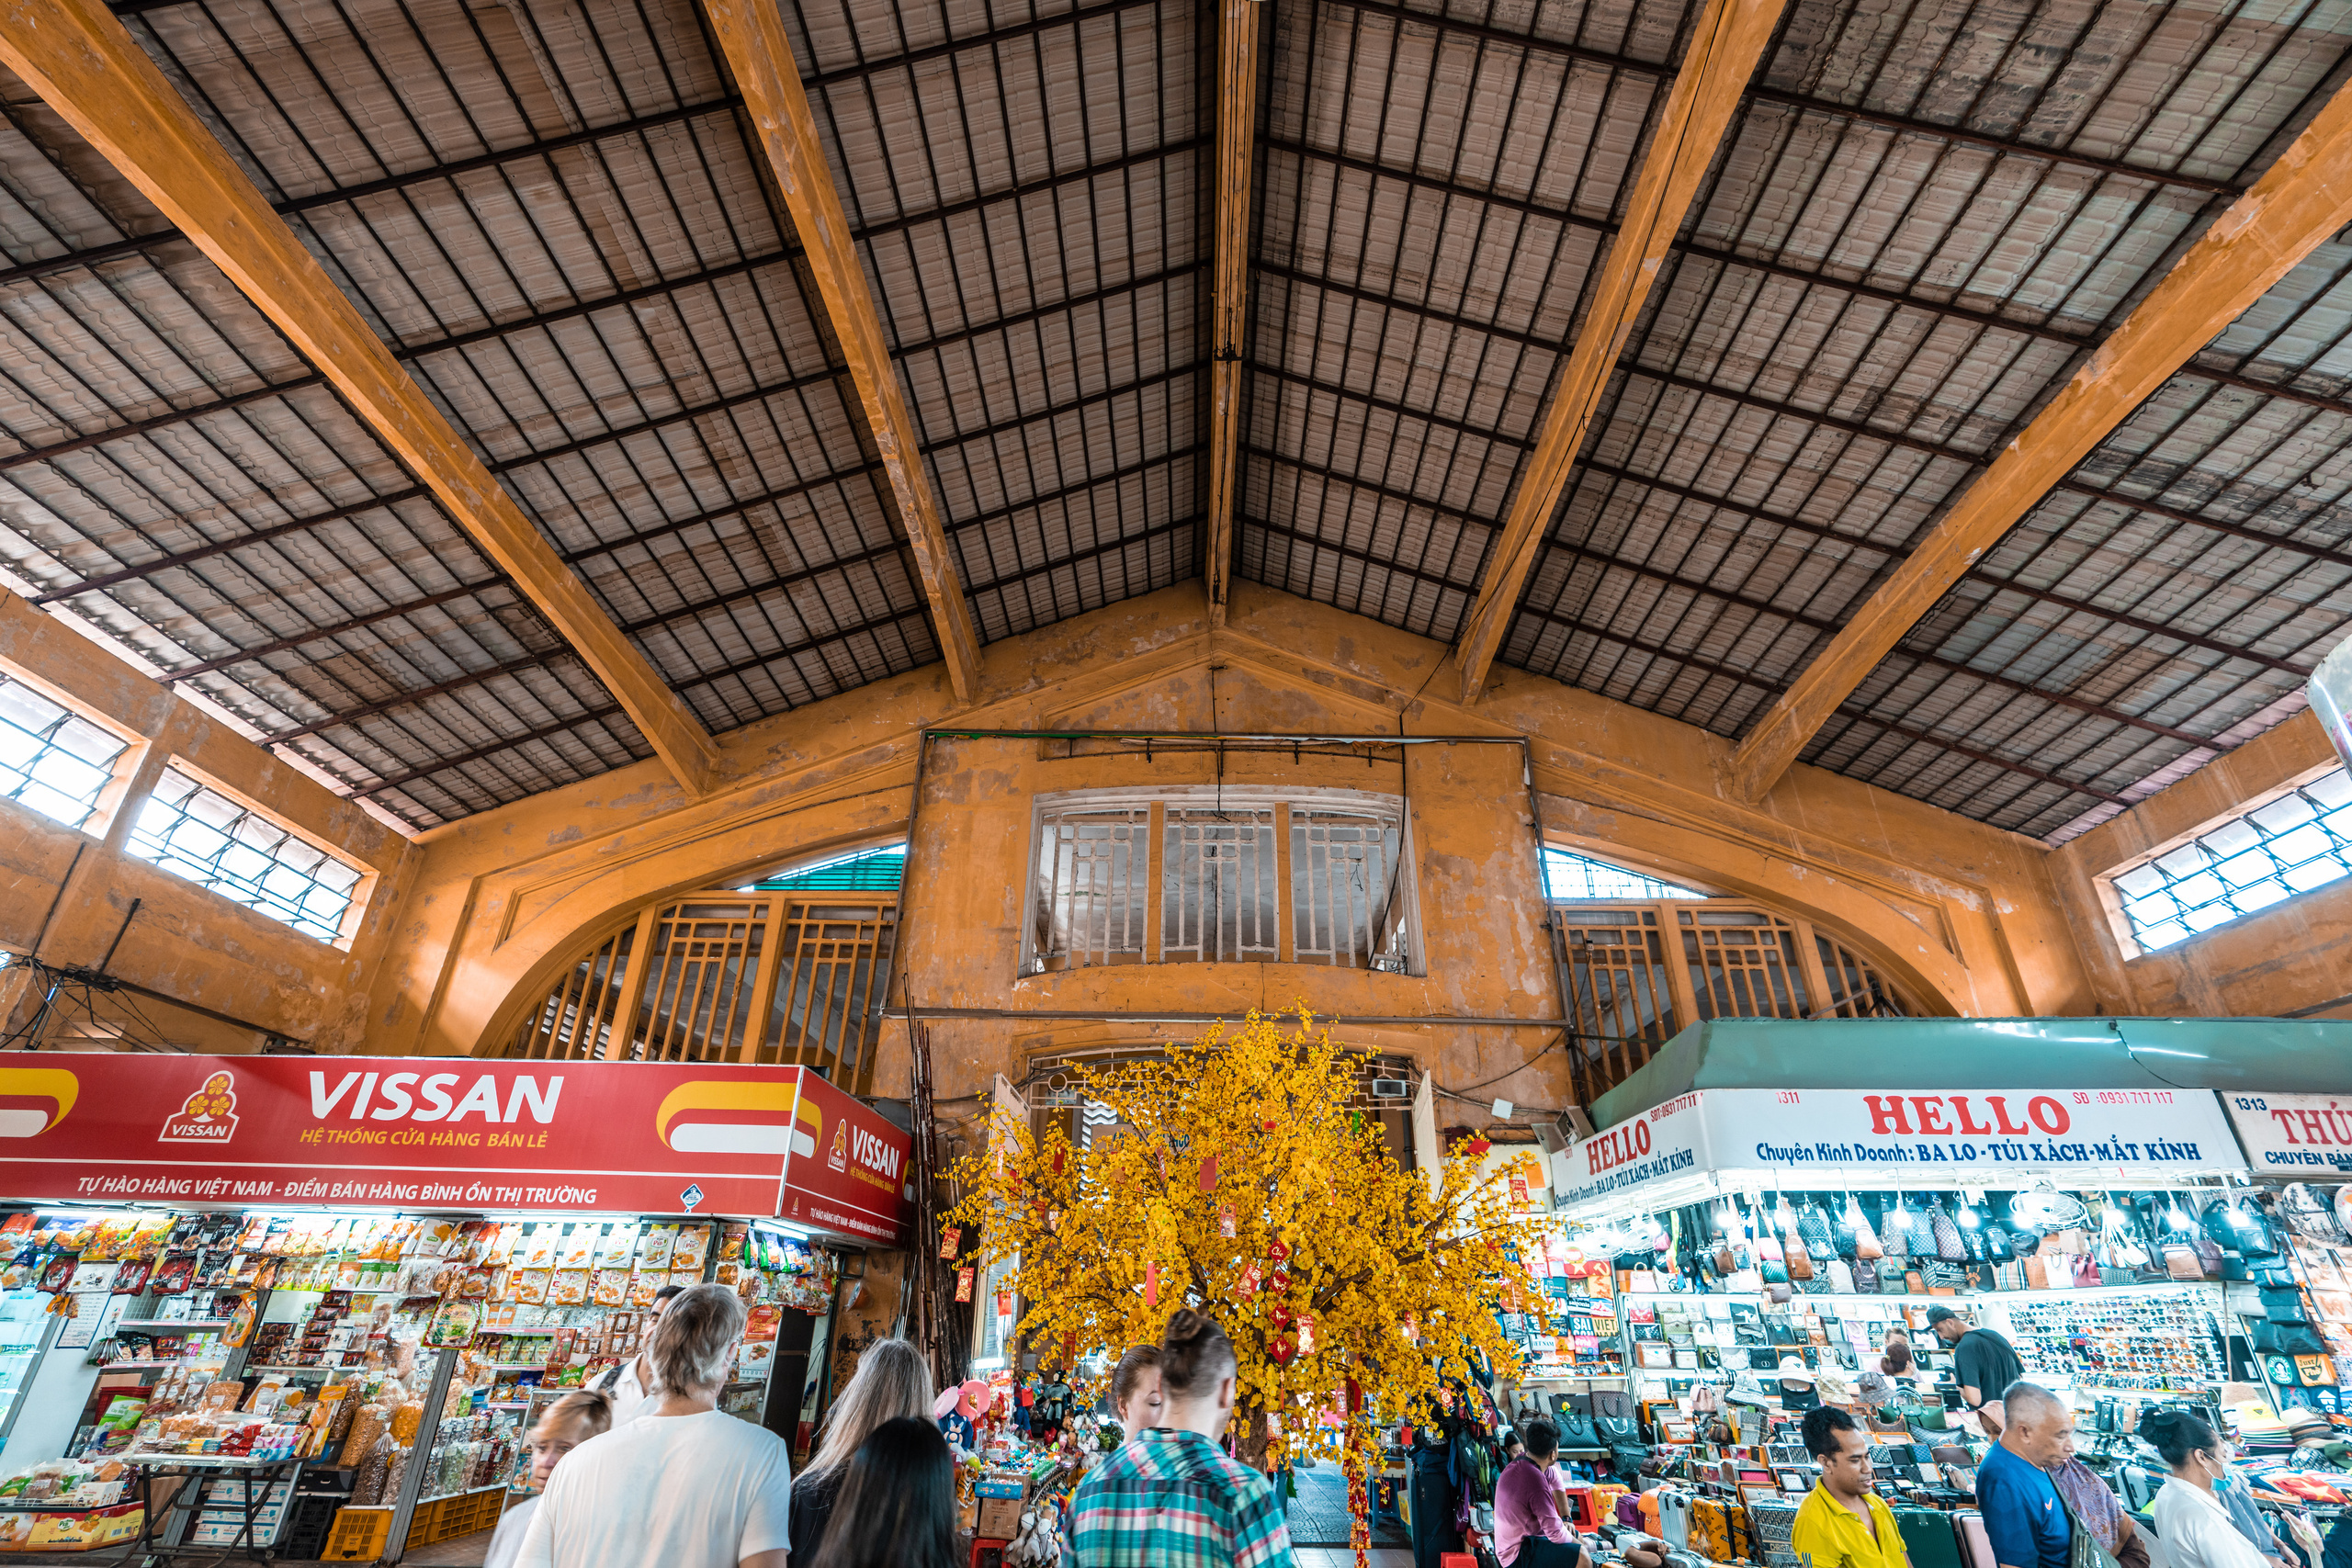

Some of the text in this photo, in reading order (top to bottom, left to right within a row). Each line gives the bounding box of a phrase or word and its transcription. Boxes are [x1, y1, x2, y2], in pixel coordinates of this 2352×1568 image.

[310, 1071, 564, 1123] VISSAN
[1776, 1091, 1800, 1104] 1311
[2235, 1098, 2267, 1111] 1313
[1862, 1095, 2071, 1136] HELLO
[173, 1124, 228, 1137] VISSAN
[300, 1126, 548, 1148] HỆ THỐNG CỬA HÀNG BÁN LẺ
[854, 1124, 899, 1179] VISSAN
[1586, 1119, 1651, 1176] HELLO
[1669, 1146, 1694, 1172] KÍNH
[1756, 1143, 1815, 1167] Chuyên
[1815, 1143, 1853, 1161] Kinh
[1916, 1144, 1949, 1161] BA
[1951, 1144, 1976, 1161] LO
[2143, 1137, 2202, 1161] KÍNH
[2265, 1149, 2324, 1165] CHUYÊN
[831, 1155, 844, 1168] VISSAN
[77, 1175, 105, 1196] TỰ
[101, 1175, 141, 1193] HÀO
[141, 1176, 193, 1194] HÀNG
[194, 1177, 232, 1199] VIỆT
[232, 1180, 274, 1196] NAM
[284, 1177, 327, 1197] ĐIỂM
[329, 1179, 368, 1199] BÁN
[368, 1181, 419, 1200] HÀNG
[420, 1182, 464, 1201] BÌNH
[465, 1180, 492, 1201] ỔN
[494, 1186, 523, 1206] THỊ
[526, 1185, 597, 1204] TRƯỜNG
[1573, 1317, 1591, 1331] SAI
